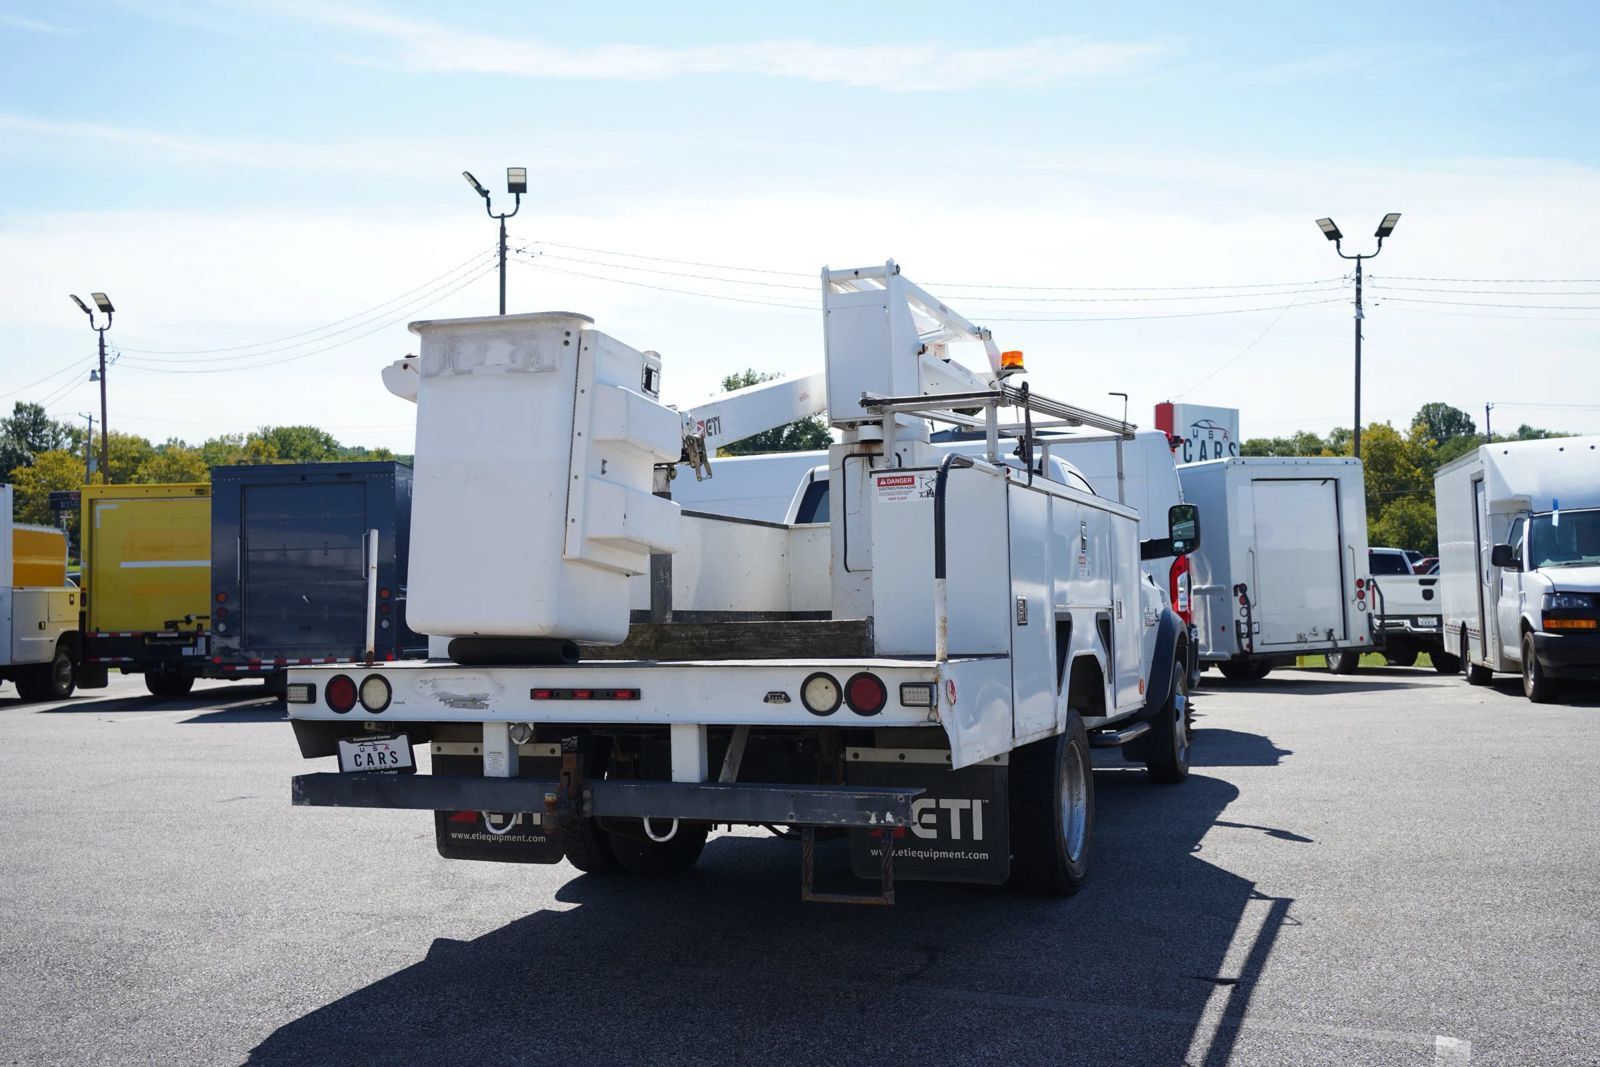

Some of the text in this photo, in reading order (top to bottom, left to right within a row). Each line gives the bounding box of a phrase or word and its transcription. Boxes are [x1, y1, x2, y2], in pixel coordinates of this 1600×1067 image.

[1192, 429, 1229, 441] USA
[1183, 438, 1237, 463] CARS
[887, 477, 912, 485] DANGER
[354, 751, 399, 767] CARS
[911, 798, 982, 840] ETI
[450, 832, 546, 842] www.etiequipment.com
